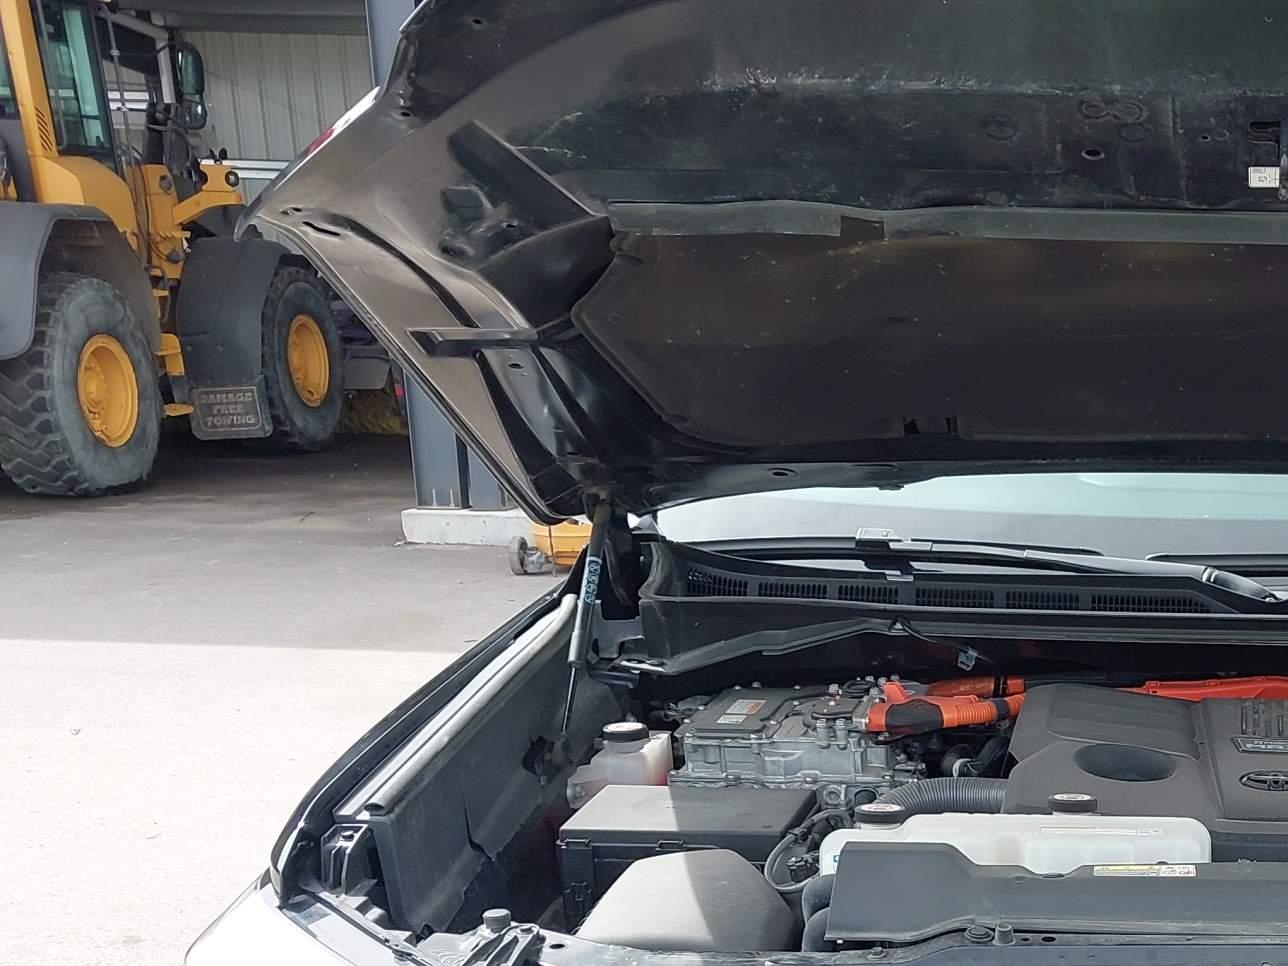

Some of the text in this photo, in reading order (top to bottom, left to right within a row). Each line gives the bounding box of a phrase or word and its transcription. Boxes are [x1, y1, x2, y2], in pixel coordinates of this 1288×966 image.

[200, 392, 252, 403] DAMAGE
[213, 404, 244, 414] FREE
[207, 415, 255, 425] TOWING
